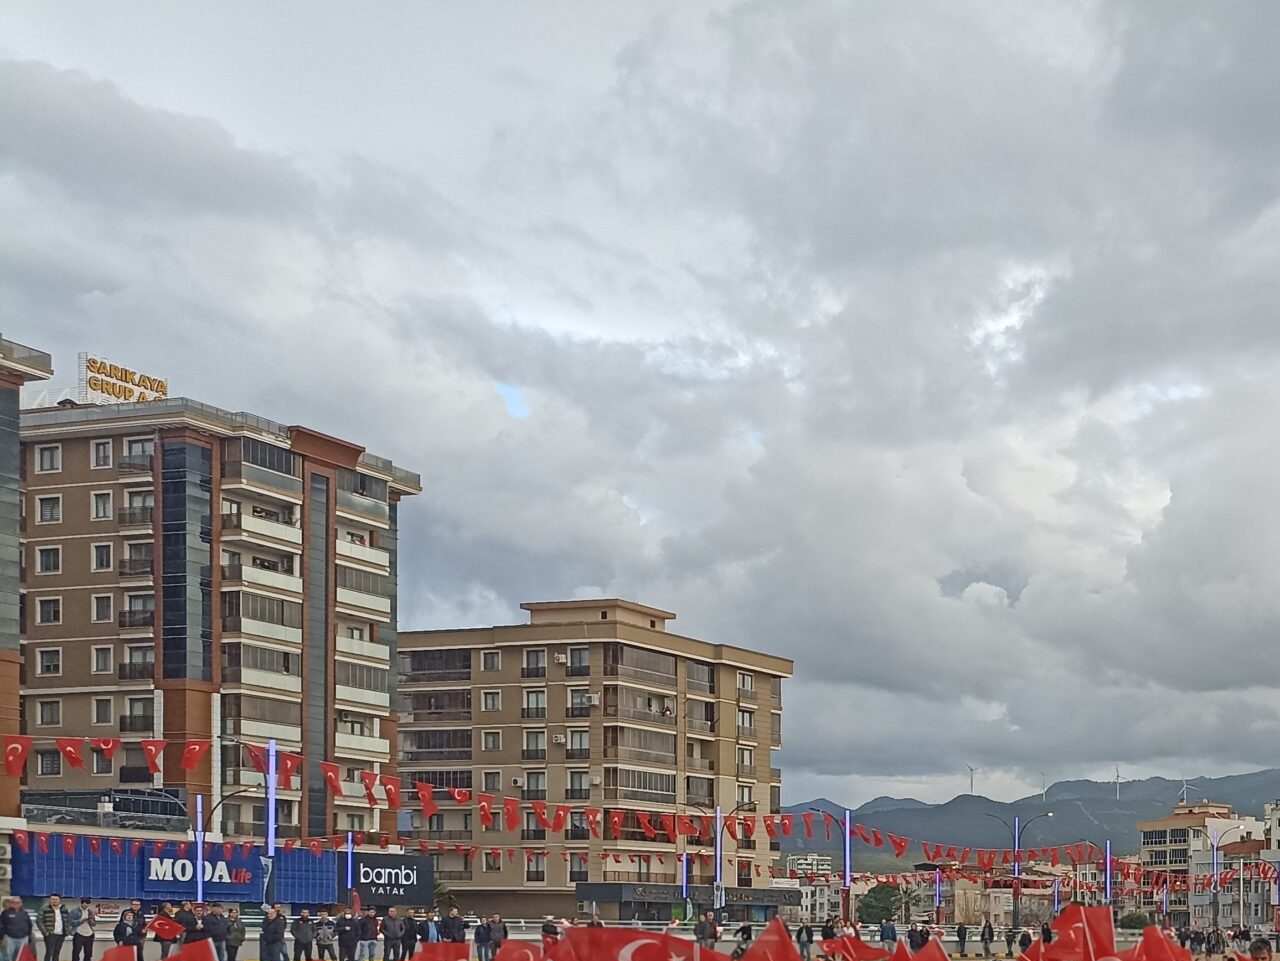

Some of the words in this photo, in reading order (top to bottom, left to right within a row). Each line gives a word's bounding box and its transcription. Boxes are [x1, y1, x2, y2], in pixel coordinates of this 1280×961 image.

[88, 376, 135, 400] GRUP
[360, 862, 417, 885] bambi
[371, 886, 405, 895] YATAK
